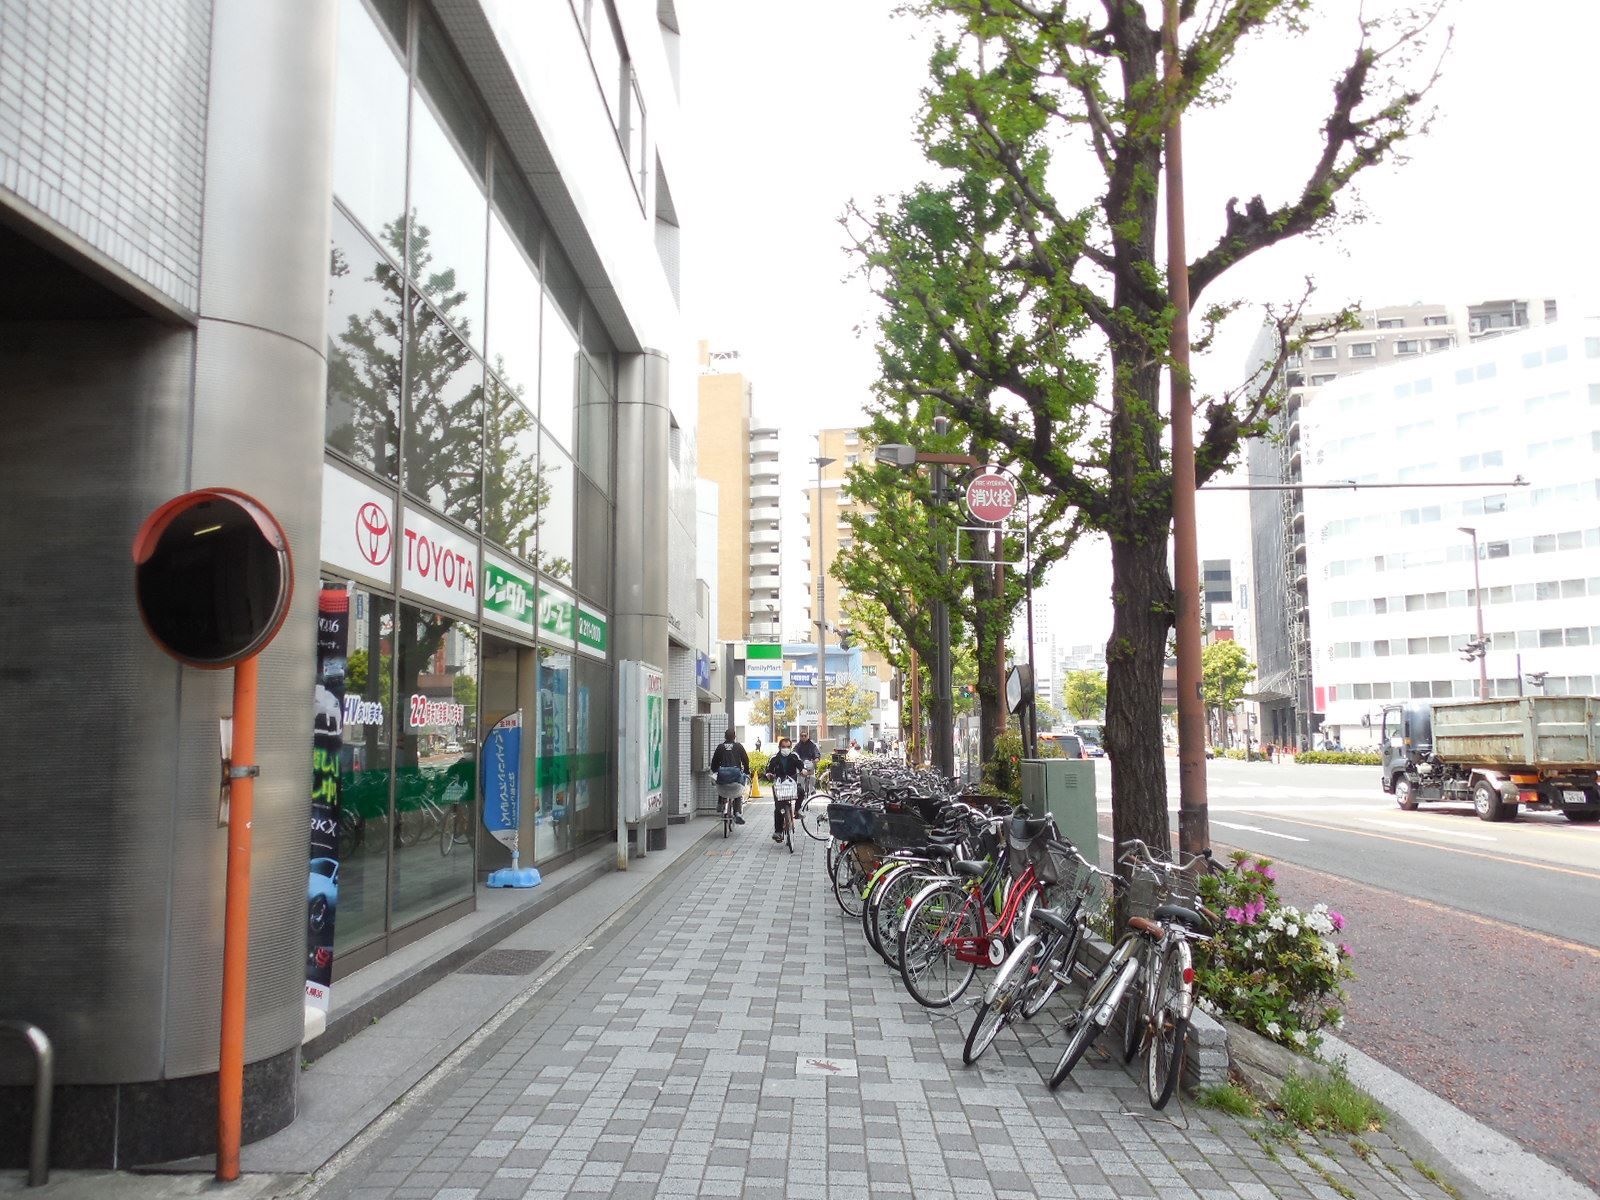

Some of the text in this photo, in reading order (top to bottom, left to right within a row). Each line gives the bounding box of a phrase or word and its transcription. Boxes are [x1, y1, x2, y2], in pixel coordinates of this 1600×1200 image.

[971, 488, 1012, 508] 消火栓
[404, 528, 475, 597] TOYOTA
[747, 664, 782, 673] FamilyMart
